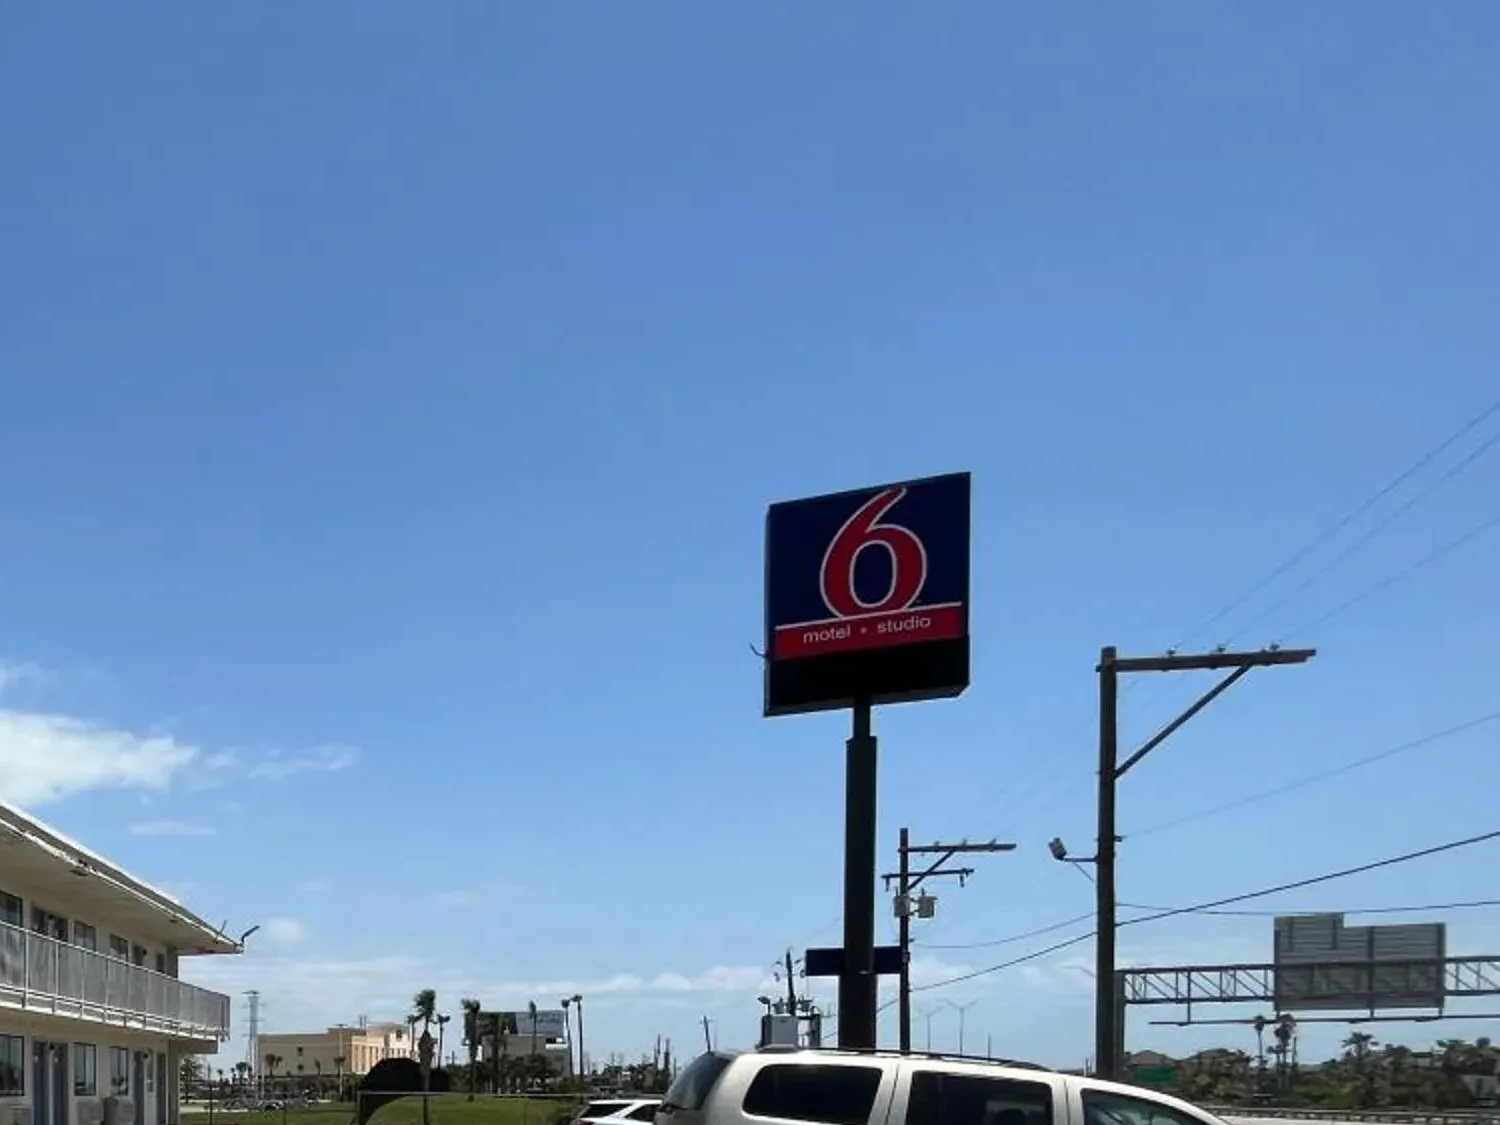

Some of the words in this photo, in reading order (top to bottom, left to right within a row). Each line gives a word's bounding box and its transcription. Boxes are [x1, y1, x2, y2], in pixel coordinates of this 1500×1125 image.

[819, 486, 928, 619] 6
[803, 624, 851, 644] motel
[877, 615, 931, 634] studio
